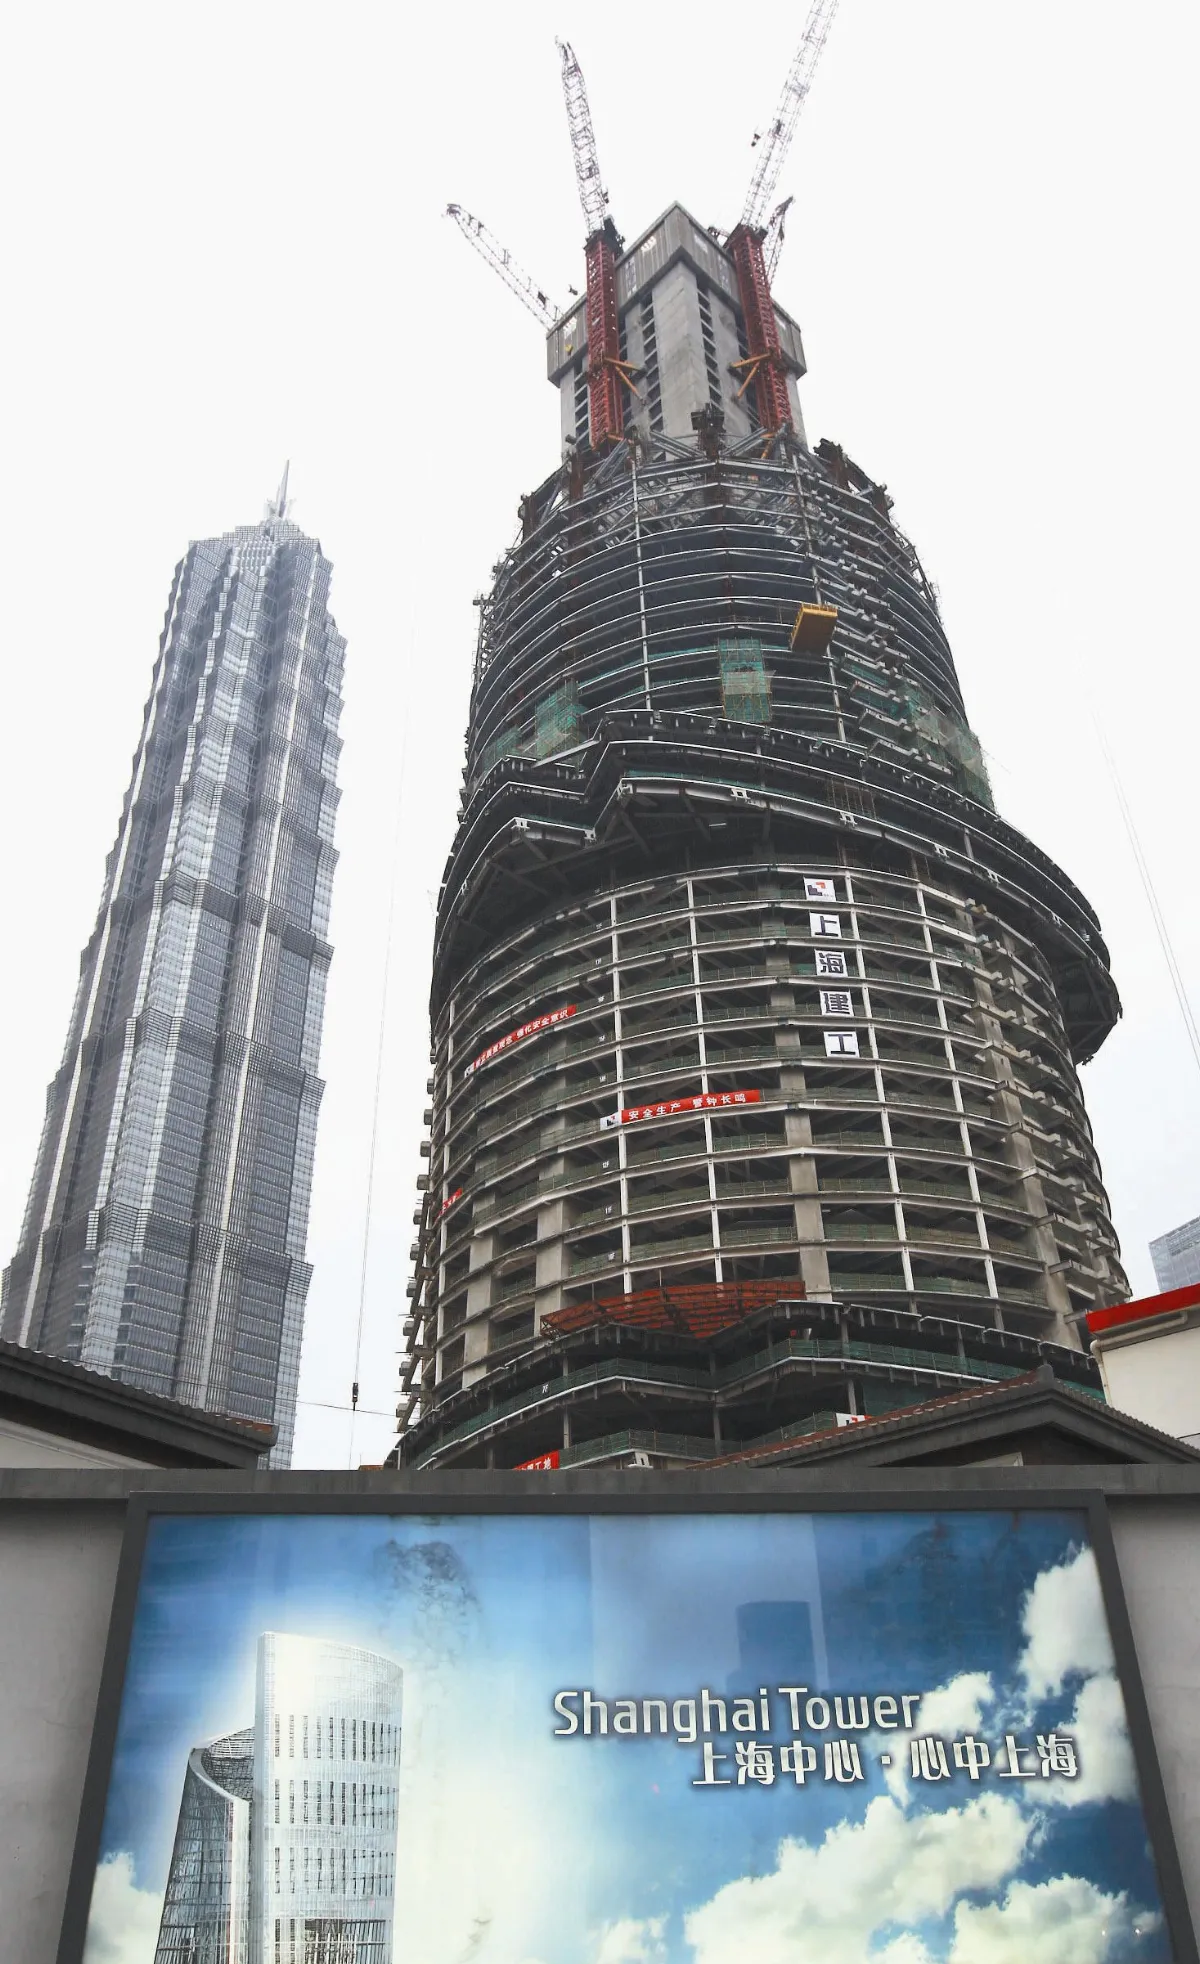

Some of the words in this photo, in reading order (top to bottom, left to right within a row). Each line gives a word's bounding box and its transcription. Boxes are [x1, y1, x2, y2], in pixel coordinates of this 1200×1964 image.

[814, 915, 856, 1056] 上海建工
[628, 1103, 682, 1120] 安全生产
[553, 1687, 770, 1742] Shanghai
[777, 1687, 921, 1731] Tower
